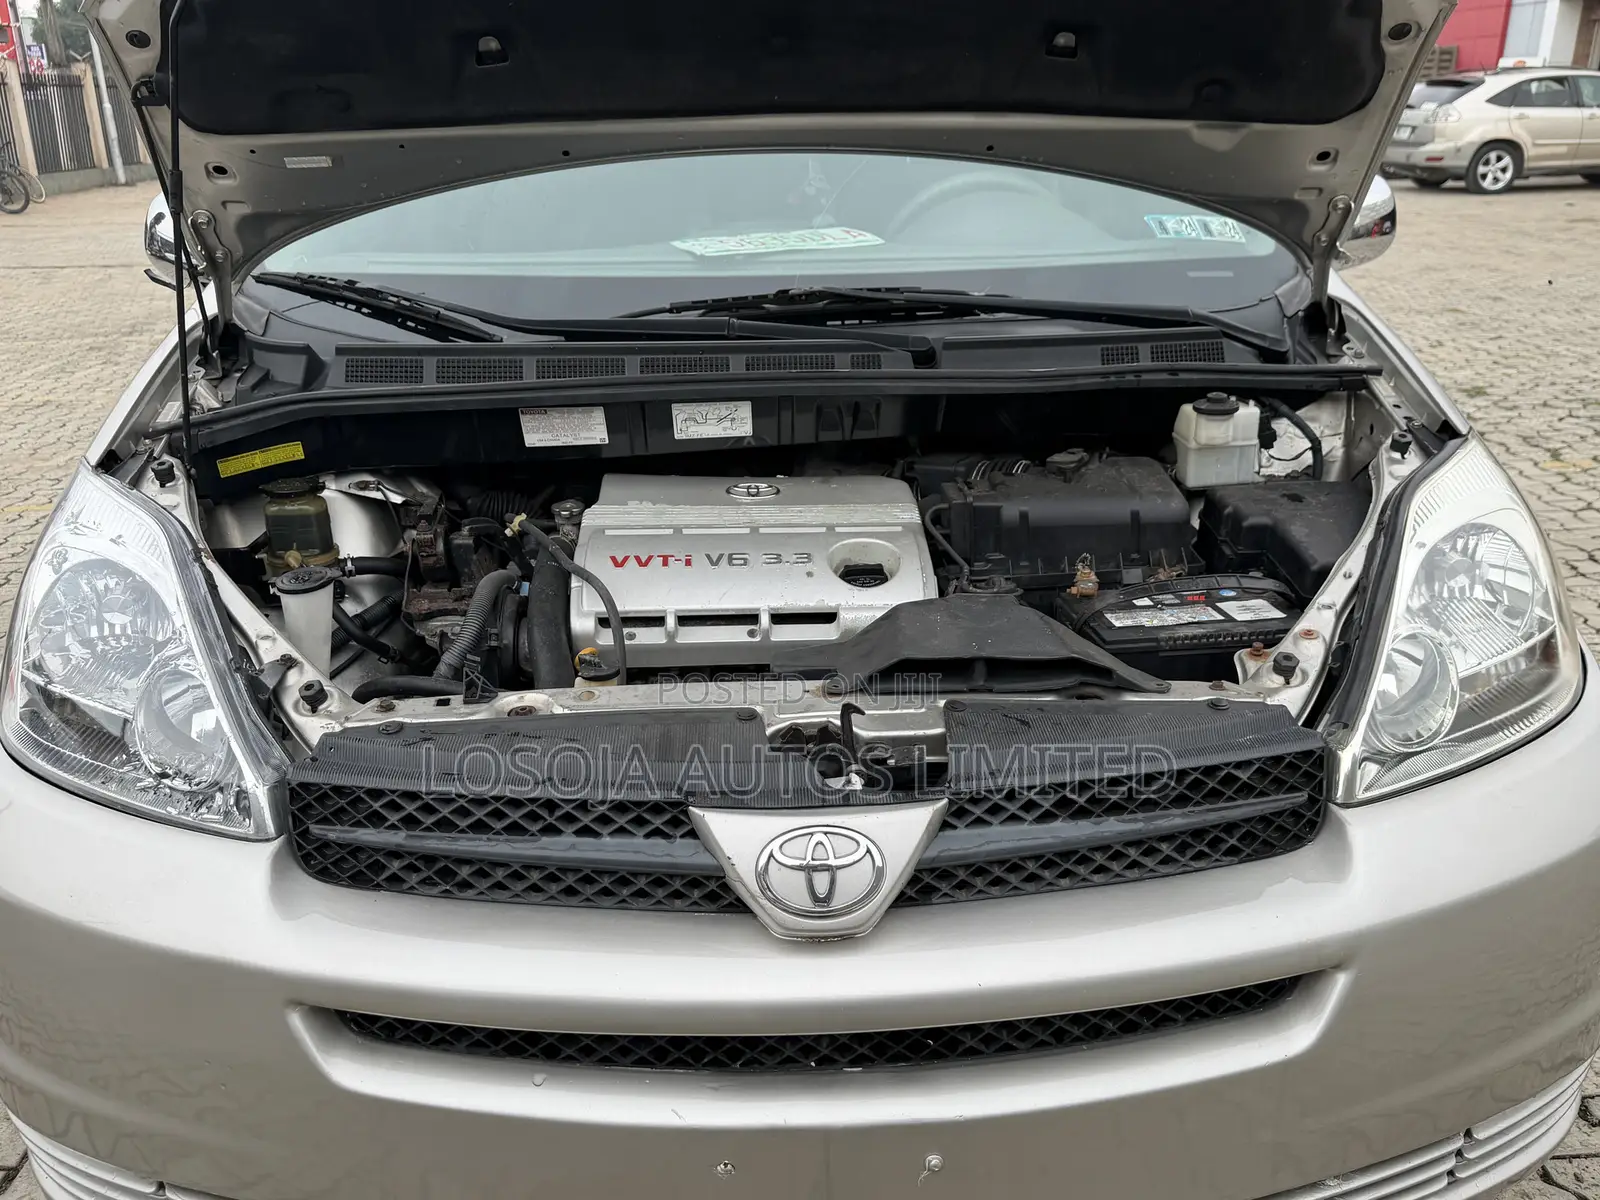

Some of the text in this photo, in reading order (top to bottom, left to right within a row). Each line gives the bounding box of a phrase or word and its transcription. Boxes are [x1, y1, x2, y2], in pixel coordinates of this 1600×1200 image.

[609, 552, 813, 569] VVT-i V6 3.3
